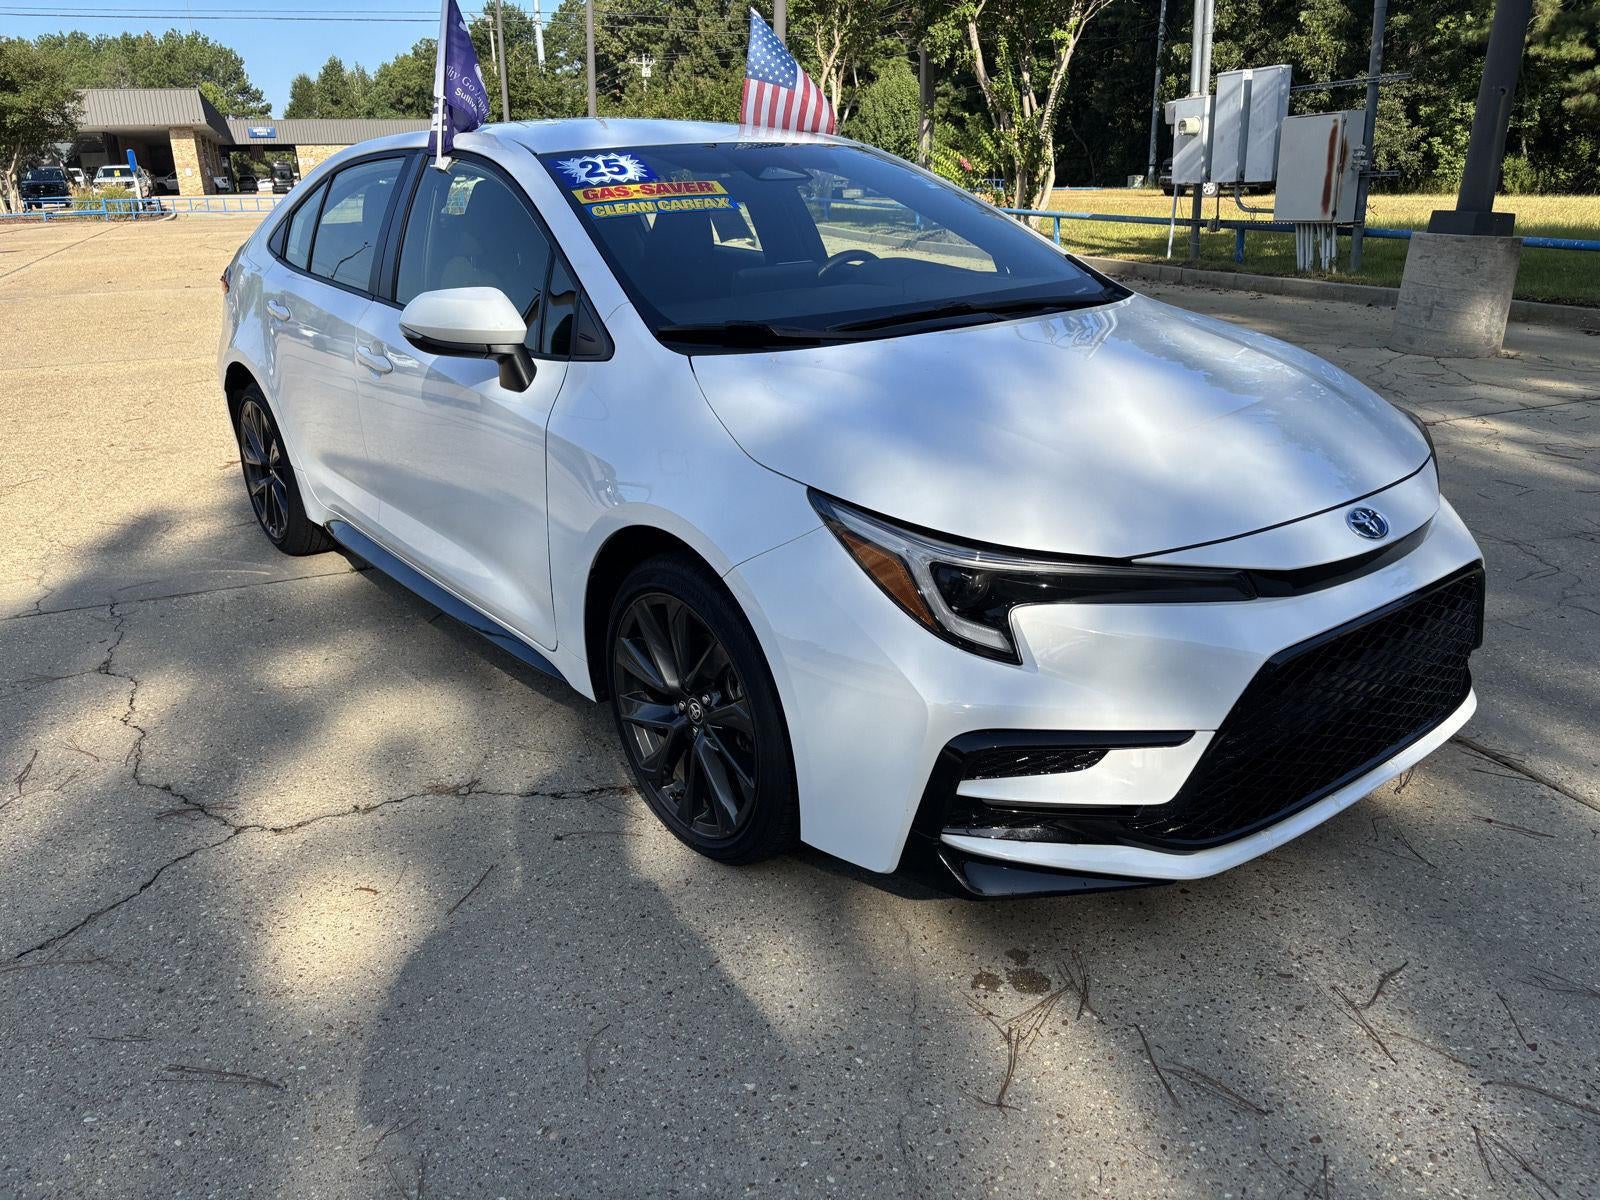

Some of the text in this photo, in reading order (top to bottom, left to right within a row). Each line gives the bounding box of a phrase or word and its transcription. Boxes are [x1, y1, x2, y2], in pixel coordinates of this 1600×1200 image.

[462, 76, 475, 91] Go
[454, 87, 478, 116] Sulliv
[579, 158, 628, 178] 25
[582, 180, 717, 201] GAS-SAVER
[591, 197, 731, 218] CLEAN CARFAX
